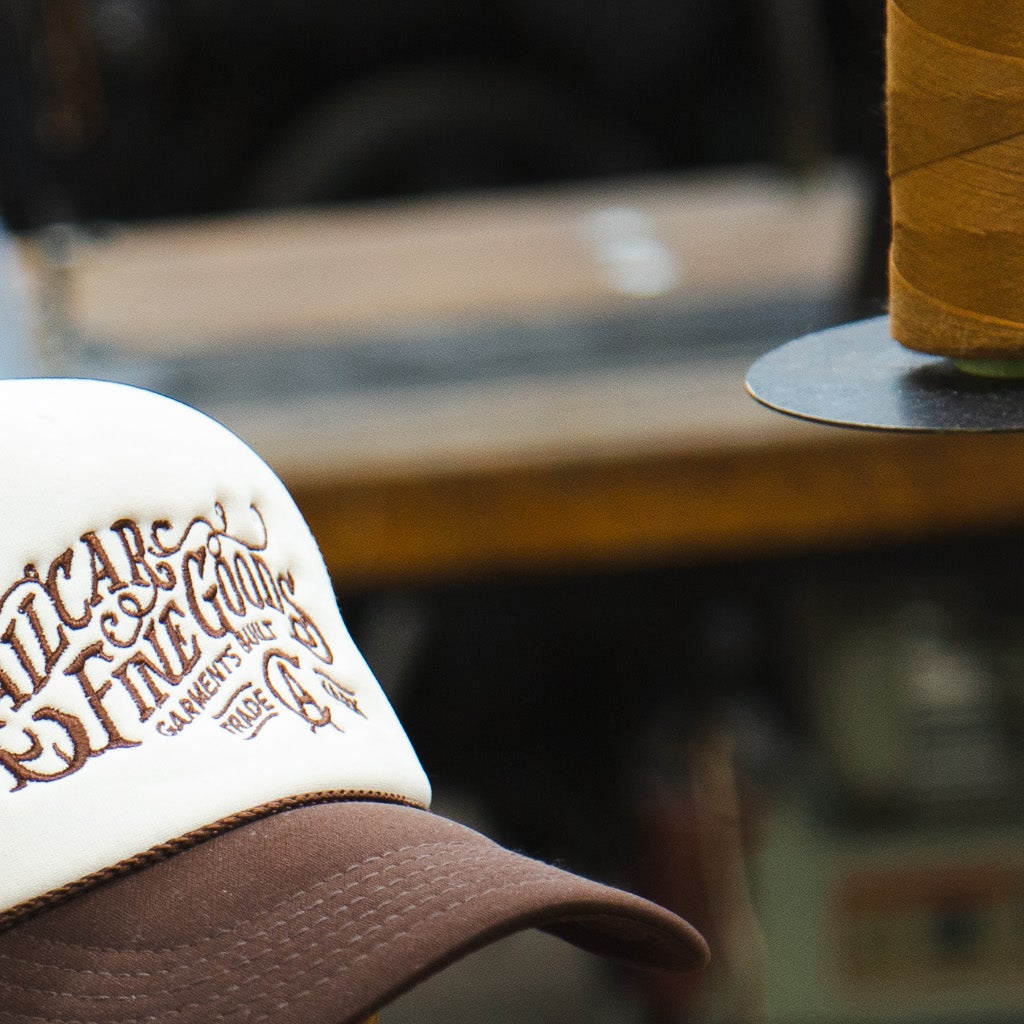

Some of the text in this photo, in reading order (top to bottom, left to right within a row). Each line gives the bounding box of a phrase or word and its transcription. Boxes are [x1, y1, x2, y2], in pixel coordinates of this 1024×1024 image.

[63, 546, 334, 751] FINE GOODS
[156, 619, 278, 737] GARMENTS BUILT
[219, 688, 275, 735] TRADE
